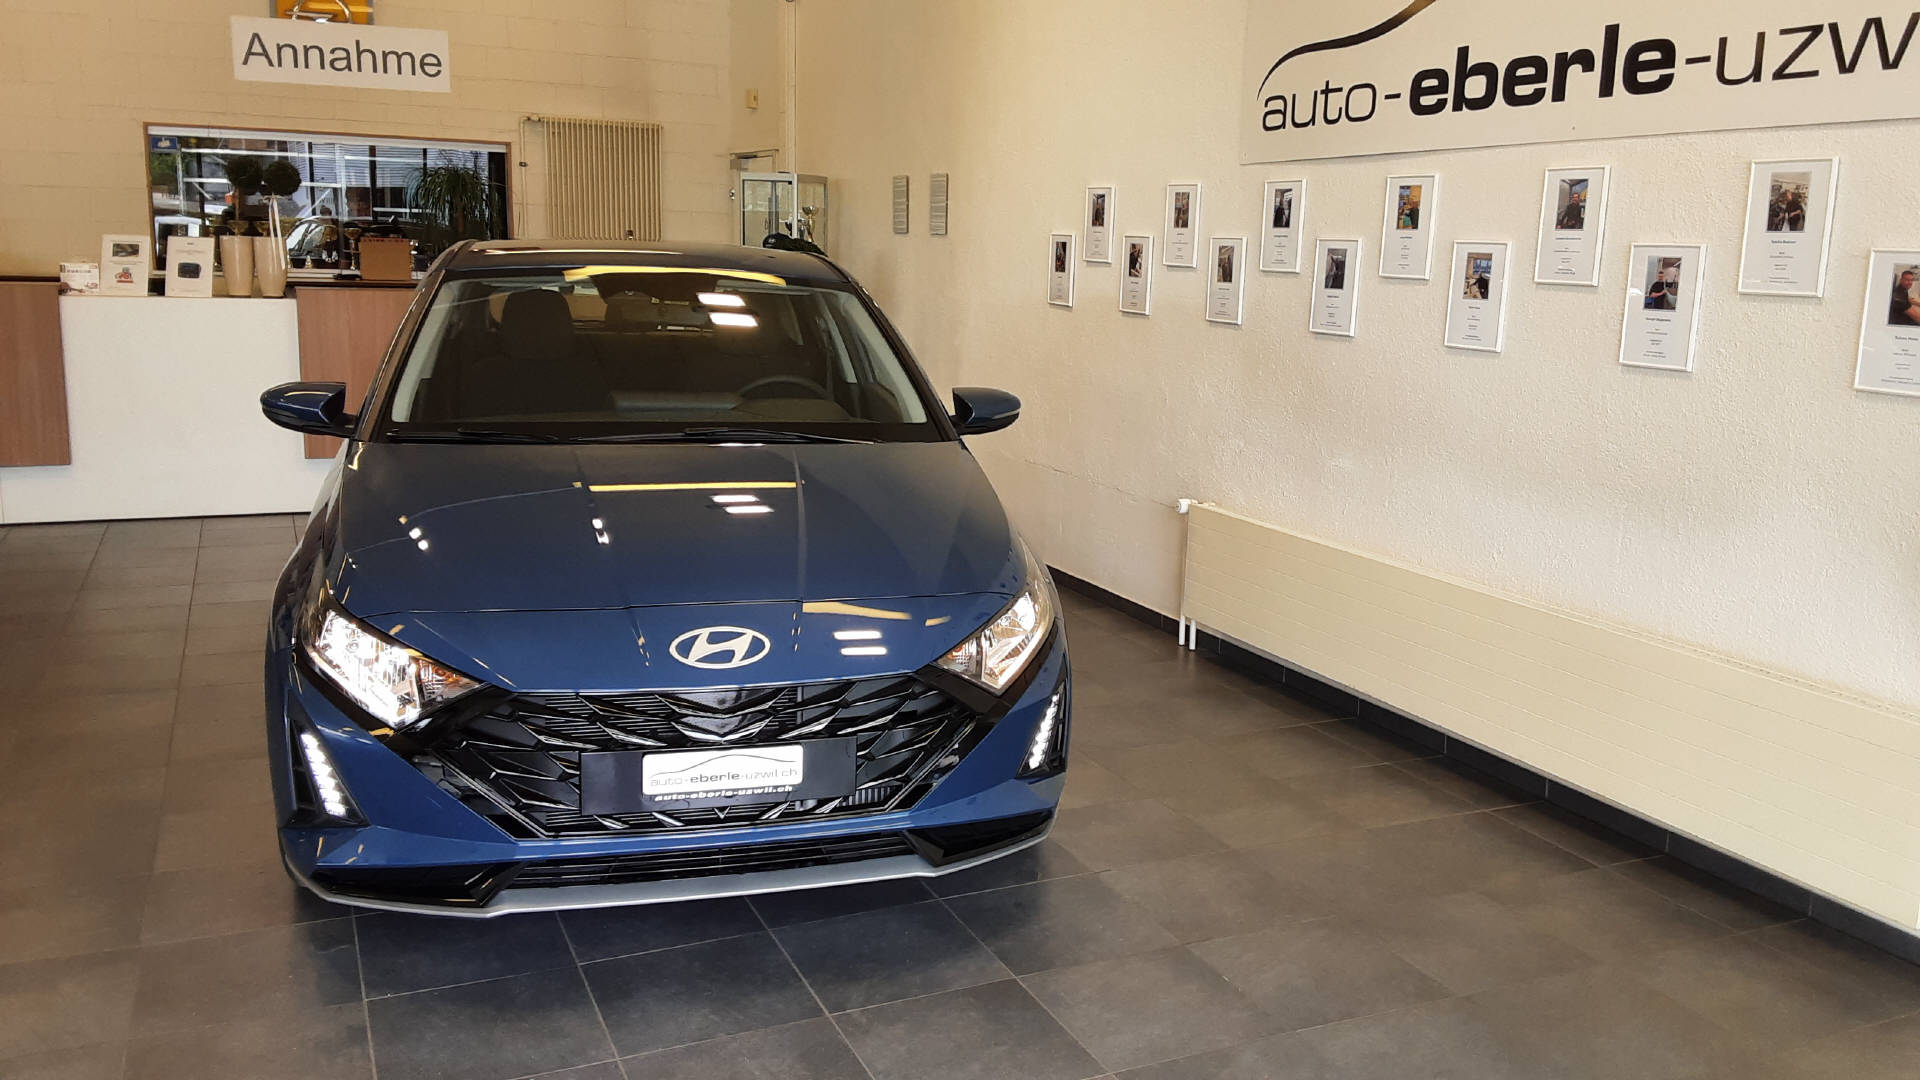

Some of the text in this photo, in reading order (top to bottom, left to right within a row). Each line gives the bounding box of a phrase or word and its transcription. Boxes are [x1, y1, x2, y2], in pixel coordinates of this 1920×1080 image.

[242, 32, 443, 78] Annahme
[650, 768, 798, 787] auto-eberle-uzwilch
[654, 785, 793, 802] auto-eberle-uzwil.ch
